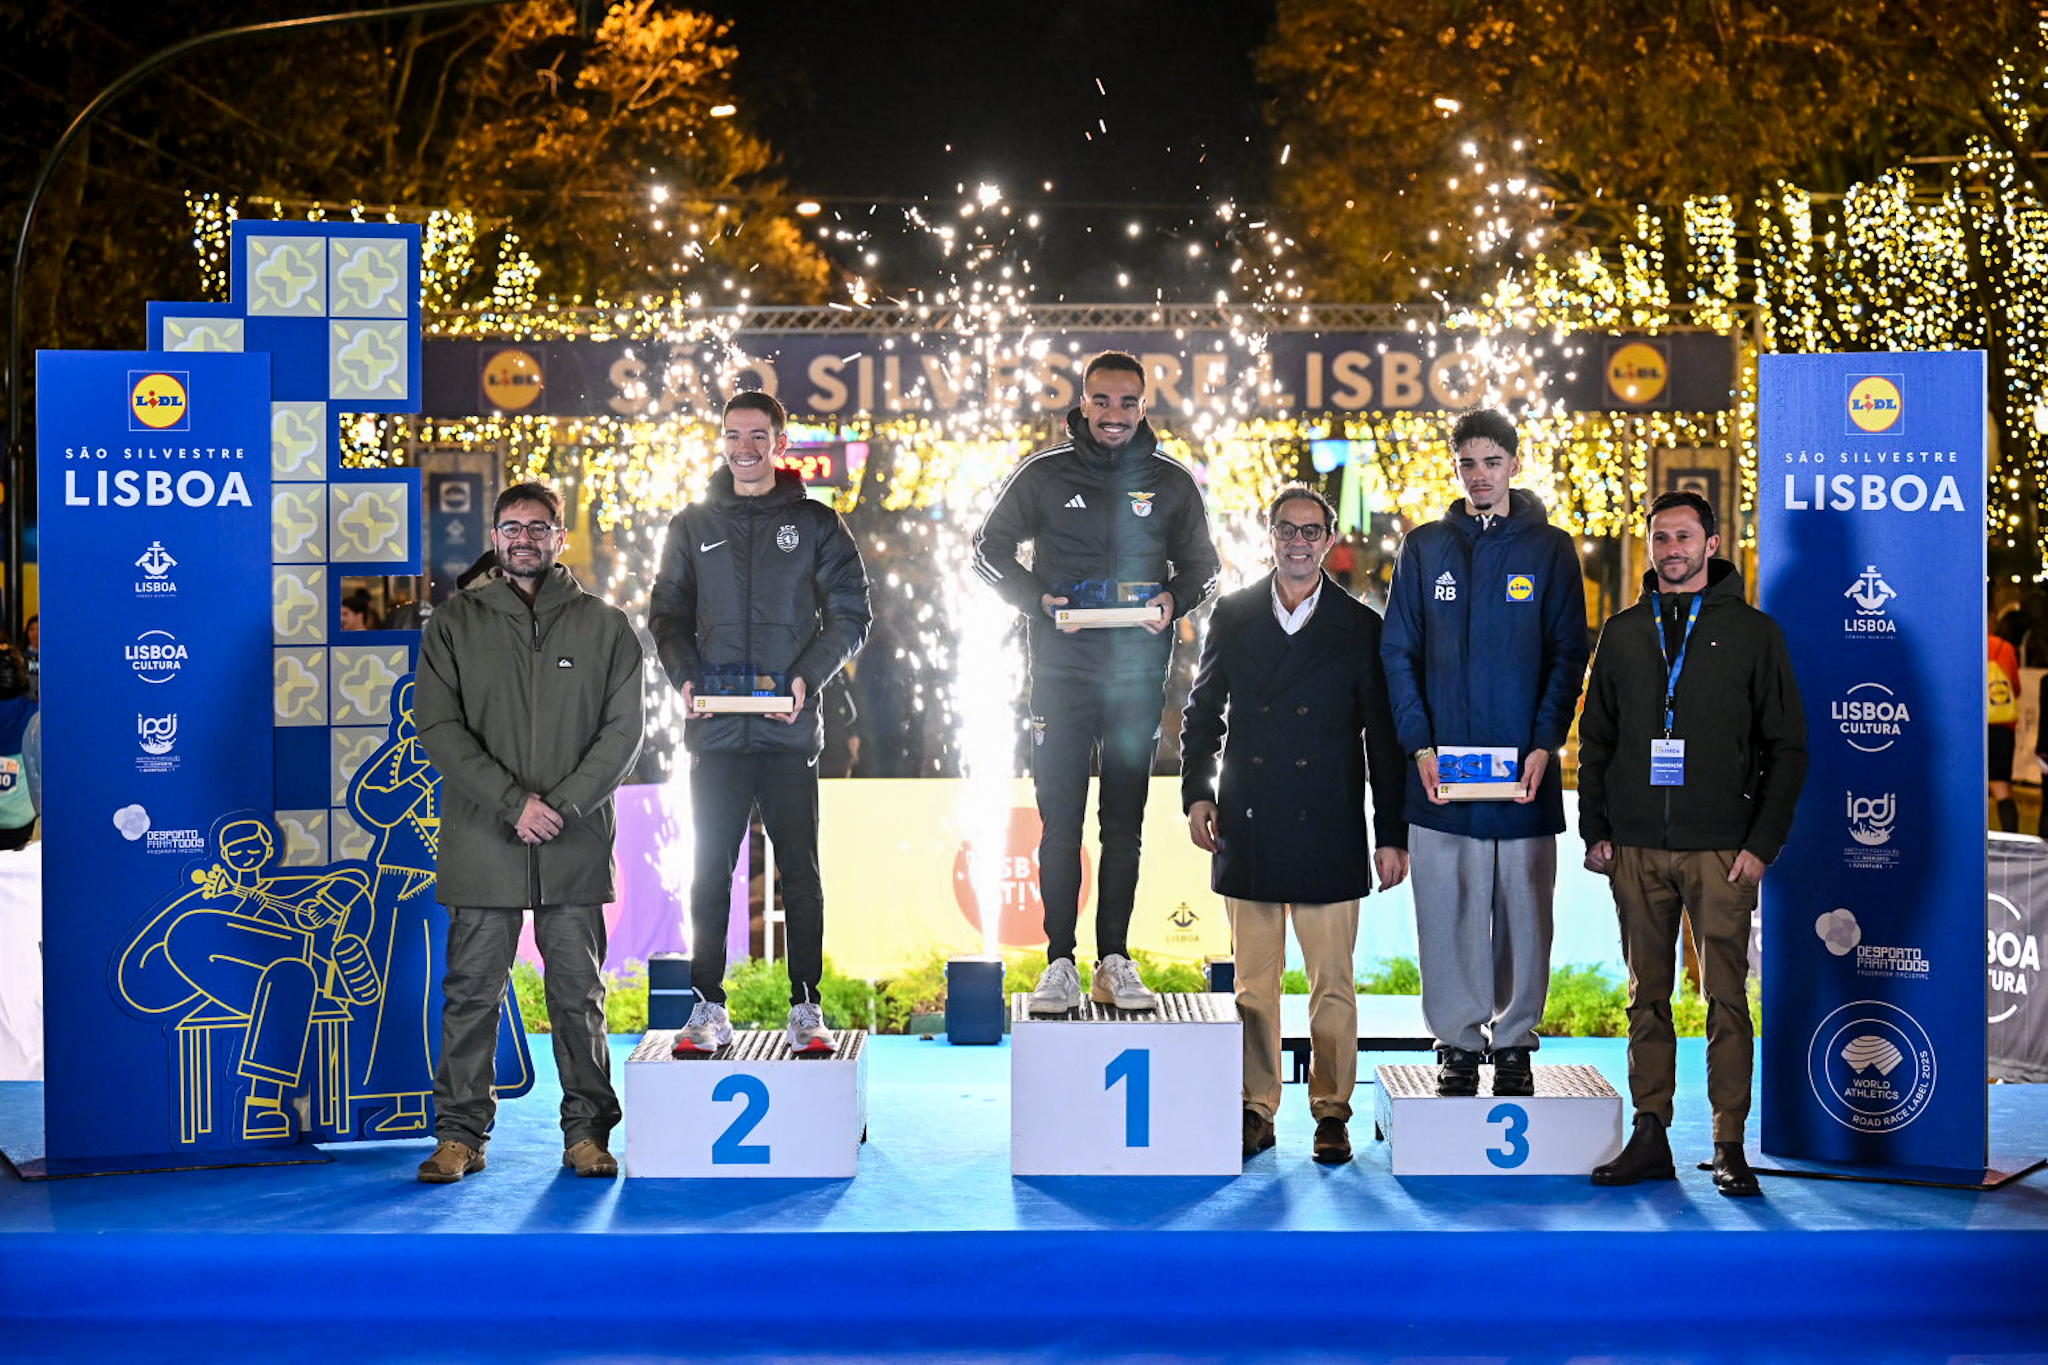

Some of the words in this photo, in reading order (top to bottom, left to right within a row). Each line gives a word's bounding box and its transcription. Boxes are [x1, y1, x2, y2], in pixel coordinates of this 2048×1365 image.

[807, 354, 1228, 411] SILVESRE
[65, 446, 107, 459] SÃO
[124, 448, 244, 459] SILVESTRE
[1785, 451, 1825, 464] SÃO
[1840, 451, 1958, 464] SILVESTRE
[65, 470, 253, 507] LISBOA
[1785, 473, 1966, 512] LISBOA
[135, 582, 177, 593] LISBOA
[1434, 585, 1457, 601] RB
[1844, 618, 1896, 632] LISBOA
[125, 645, 189, 660] LISBOA
[132, 661, 181, 670] CULTURA
[1832, 701, 1910, 722] LISBOA
[138, 713, 177, 741] ipdj
[1840, 722, 1902, 735] CULTURA
[1846, 790, 1896, 828] ipdj
[147, 829, 199, 840] DESPORTO
[1166, 934, 1200, 943] LISBOA
[1857, 945, 1922, 960] DESPORTO
[1852, 1114, 1881, 1127] ROAD
[1884, 1108, 1911, 1126] RACE
[1907, 1082, 1930, 1112] LABEL
[1920, 1050, 1931, 1079] 2025
[1853, 1078, 1891, 1090] WORLD
[1105, 1048, 1150, 1147] 1
[1844, 1087, 1899, 1100] ATHLETICS
[711, 1074, 770, 1165] 2
[1486, 1103, 1530, 1169] 3
